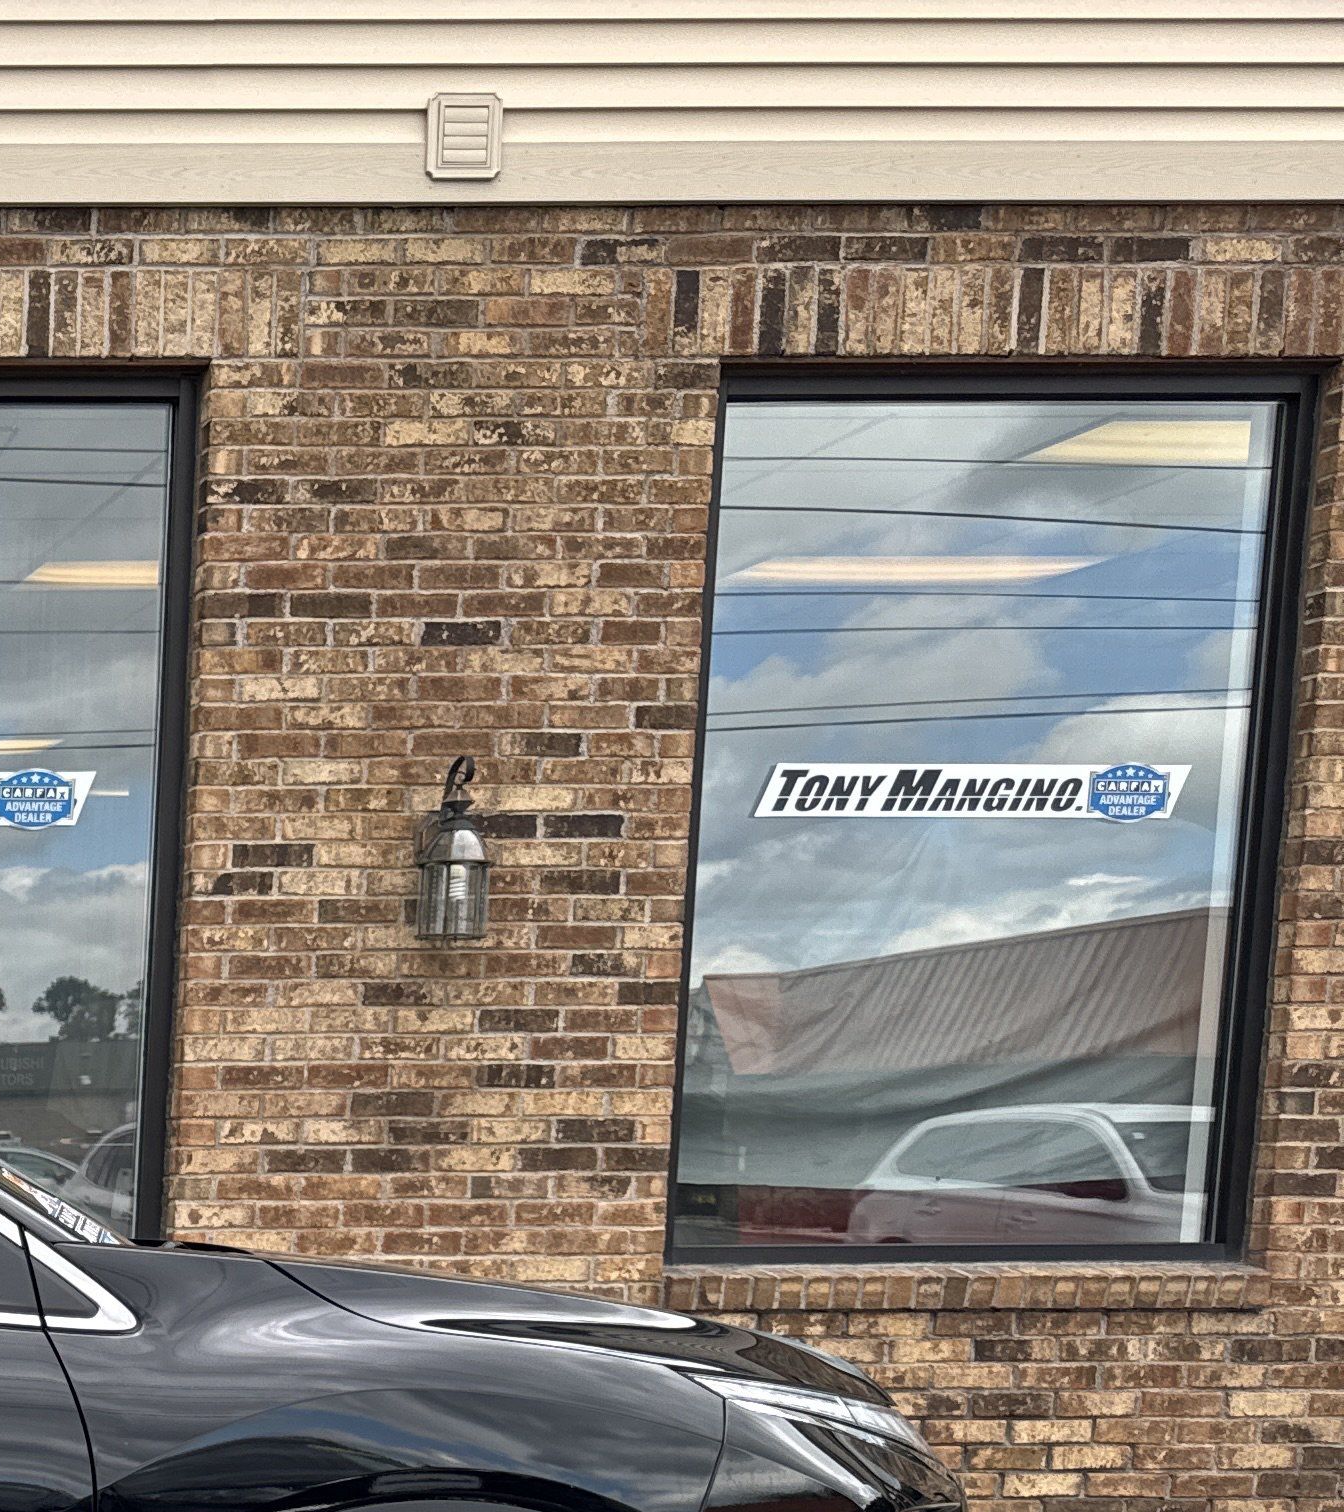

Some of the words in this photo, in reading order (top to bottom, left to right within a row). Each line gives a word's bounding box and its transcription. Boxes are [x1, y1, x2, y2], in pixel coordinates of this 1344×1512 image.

[0, 786, 69, 800] CARFAX
[771, 769, 888, 811] TONY
[1095, 780, 1164, 793] CARFAX
[1108, 805, 1146, 816] DEALER
[14, 812, 52, 823] DEALER
